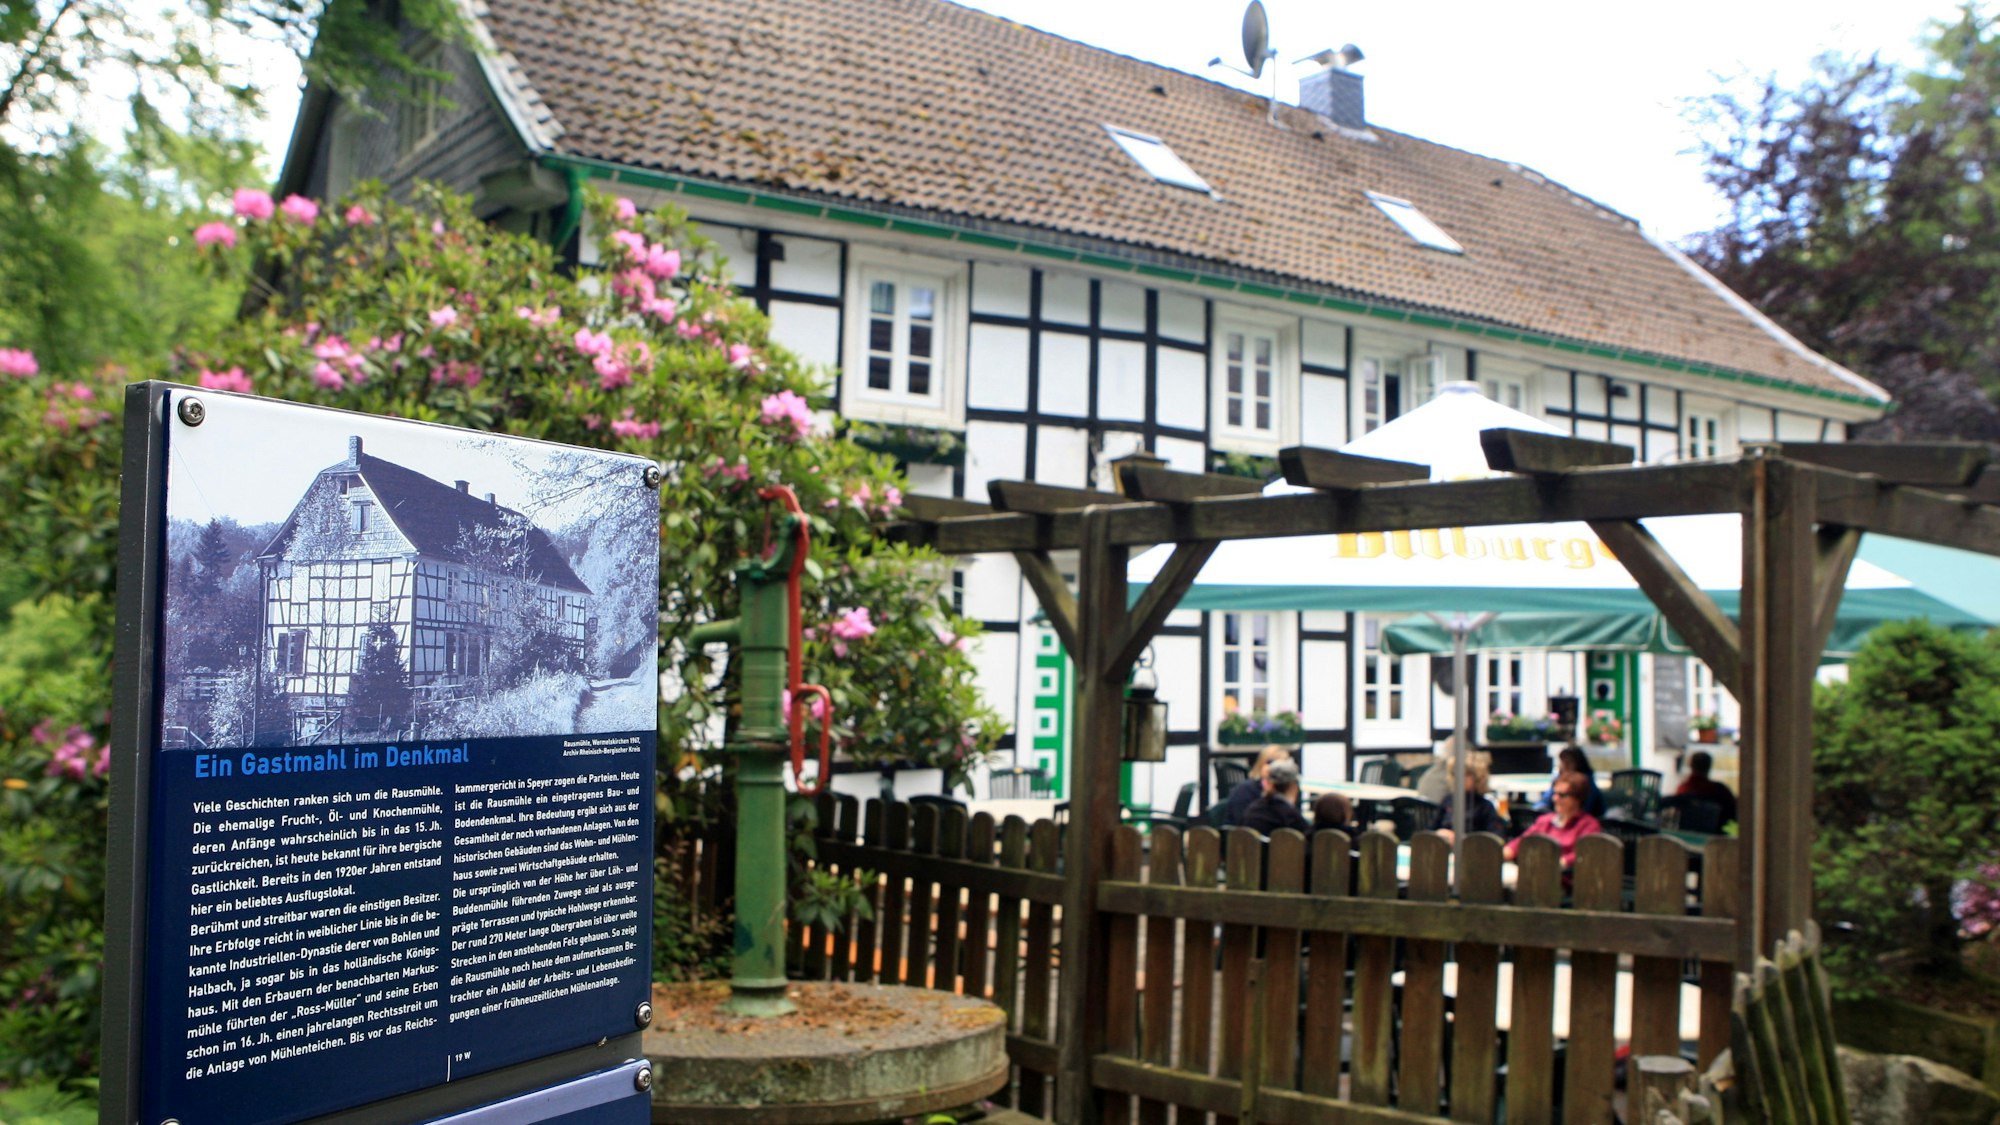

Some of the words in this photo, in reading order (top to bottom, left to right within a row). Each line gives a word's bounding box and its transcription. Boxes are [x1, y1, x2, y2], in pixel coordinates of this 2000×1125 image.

[195, 754, 232, 778] Ein
[241, 748, 347, 775] Gastmahl
[354, 748, 378, 769] im
[386, 743, 469, 767] Denkmal
[193, 801, 221, 813] Viele
[226, 797, 290, 811] Geschichten
[294, 794, 329, 806] ranken
[332, 792, 352, 803] sich
[356, 793, 371, 801] um
[374, 789, 388, 800] die
[392, 785, 443, 798] Rausmühle.
[455, 780, 516, 793] kammergericht
[518, 779, 525, 789] in
[527, 778, 553, 790] Speyer
[554, 777, 575, 788] zogen
[576, 774, 587, 784] die
[589, 772, 619, 783] Parteien.
[621, 771, 640, 780] Heute
[193, 822, 211, 834] Die
[218, 817, 275, 832] ehemalige
[281, 814, 322, 826] Frucht-,
[328, 809, 343, 822] Öl-
[349, 809, 367, 820] und
[373, 803, 443, 818] Knochenmühle,
[455, 813, 516, 828] Bodendenkmal.
[518, 812, 534, 822] Ihre
[536, 809, 575, 820] Bedeutung
[577, 806, 598, 818] ergibt
[599, 804, 613, 814] sich
[614, 804, 626, 812] aus
[628, 802, 639, 811] der
[192, 843, 225, 854] deren
[231, 837, 275, 851] Anfänge
[281, 828, 357, 845] wahrscheinlich
[362, 827, 376, 838] bis
[381, 825, 389, 836] in
[394, 824, 410, 834] das
[415, 821, 427, 832] 15.
[429, 820, 442, 831] Jh.
[192, 857, 273, 875] zurückreichen,
[275, 854, 288, 866] ist
[291, 852, 319, 864] heute
[322, 847, 360, 861] bekannt
[363, 845, 377, 856] für
[379, 844, 397, 854] ihre
[399, 838, 442, 853] bergische
[453, 849, 503, 863] historischen
[504, 844, 542, 857] Gebäuden
[543, 841, 559, 852] sind
[560, 841, 573, 850] das
[574, 838, 597, 848] Wohn-
[598, 835, 611, 845] und
[612, 833, 639, 844] Mühlen-
[191, 877, 258, 895] Gastlichkeit.
[262, 873, 299, 887] Bereits
[302, 871, 311, 882] in
[314, 869, 332, 880] den
[335, 865, 368, 878] 1920er
[370, 862, 401, 874] Jahren
[404, 855, 442, 870] entstand
[190, 919, 239, 936] Berühmt
[241, 916, 261, 929] und
[263, 911, 308, 926] streitbar
[310, 907, 341, 919] waren
[343, 903, 357, 914] die
[359, 898, 401, 912] einstigen
[403, 893, 440, 906] Besitzer.
[191, 903, 213, 916] hier
[216, 900, 232, 912] ein
[235, 896, 283, 910] beliebtes
[285, 884, 355, 903] Ausflugslokal.
[452, 921, 479, 936] prägte
[480, 915, 519, 928] Terrassen
[521, 910, 535, 922] und
[536, 906, 567, 921] typische
[568, 902, 602, 914] Hohlwege
[603, 895, 638, 908] erkennbar.
[189, 962, 227, 977] kannte
[230, 942, 343, 970] Industriellen-Dynastie
[345, 940, 371, 951] derer
[373, 937, 389, 946] von
[391, 931, 422, 944] Bohlen
[424, 926, 440, 938] und
[190, 945, 212, 957] Ihre
[215, 937, 261, 953] Erbfolge
[264, 931, 293, 945] reicht
[296, 929, 305, 940] in
[307, 923, 358, 938] weiblicher
[360, 918, 383, 931] Linie
[385, 915, 398, 926] bis
[400, 914, 408, 924] in
[410, 911, 424, 922] die
[426, 910, 440, 920] be-
[188, 1005, 218, 1018] haus.
[222, 999, 239, 1012] Mit
[242, 996, 261, 1008] den
[265, 988, 313, 1004] Erbauern
[316, 983, 333, 994] der
[336, 972, 399, 990] benachbarten
[402, 964, 439, 978] Markus-
[189, 980, 236, 998] Halbach,
[240, 977, 251, 992] ja
[255, 973, 285, 987] sogar
[290, 968, 304, 980] bis
[309, 965, 318, 976] in
[322, 963, 340, 974] das
[344, 951, 402, 970] holländische
[406, 946, 439, 959] Königs-
[450, 990, 484, 1003] trachter
[486, 985, 498, 996] ein
[501, 978, 526, 993] Abbild
[528, 977, 542, 987] der
[543, 970, 574, 984] Arbeits-
[576, 965, 589, 976] und
[592, 956, 636, 973] Lebensbedin-
[187, 1022, 222, 1039] mühle
[226, 1016, 266, 1031] führten
[270, 1011, 288, 1022] der
[365, 990, 382, 1003] und
[385, 987, 409, 999] seine
[413, 981, 438, 994] Erben
[449, 1008, 480, 1023] gungen
[481, 1002, 503, 1014] einer
[504, 988, 569, 1009] frühneuzeitlichen
[570, 977, 620, 994] Mühlenanlage.
[186, 1045, 219, 1059] schon
[223, 1040, 236, 1052] im
[241, 1035, 255, 1048] 16.
[257, 1032, 273, 1045] Jh.
[276, 1028, 304, 1040] einen
[306, 1015, 364, 1037] jahrelangen
[367, 1001, 422, 1021] Rechtsstreit
[424, 999, 438, 1009] um
[186, 1067, 203, 1080] die
[206, 1060, 245, 1075] Anlage
[248, 1055, 267, 1066] von
[271, 1038, 346, 1061] Mühlenteichen.
[350, 1031, 365, 1044] Bis
[368, 1029, 383, 1039] vor
[386, 1025, 402, 1035] das
[405, 1017, 437, 1031] Reichs-
